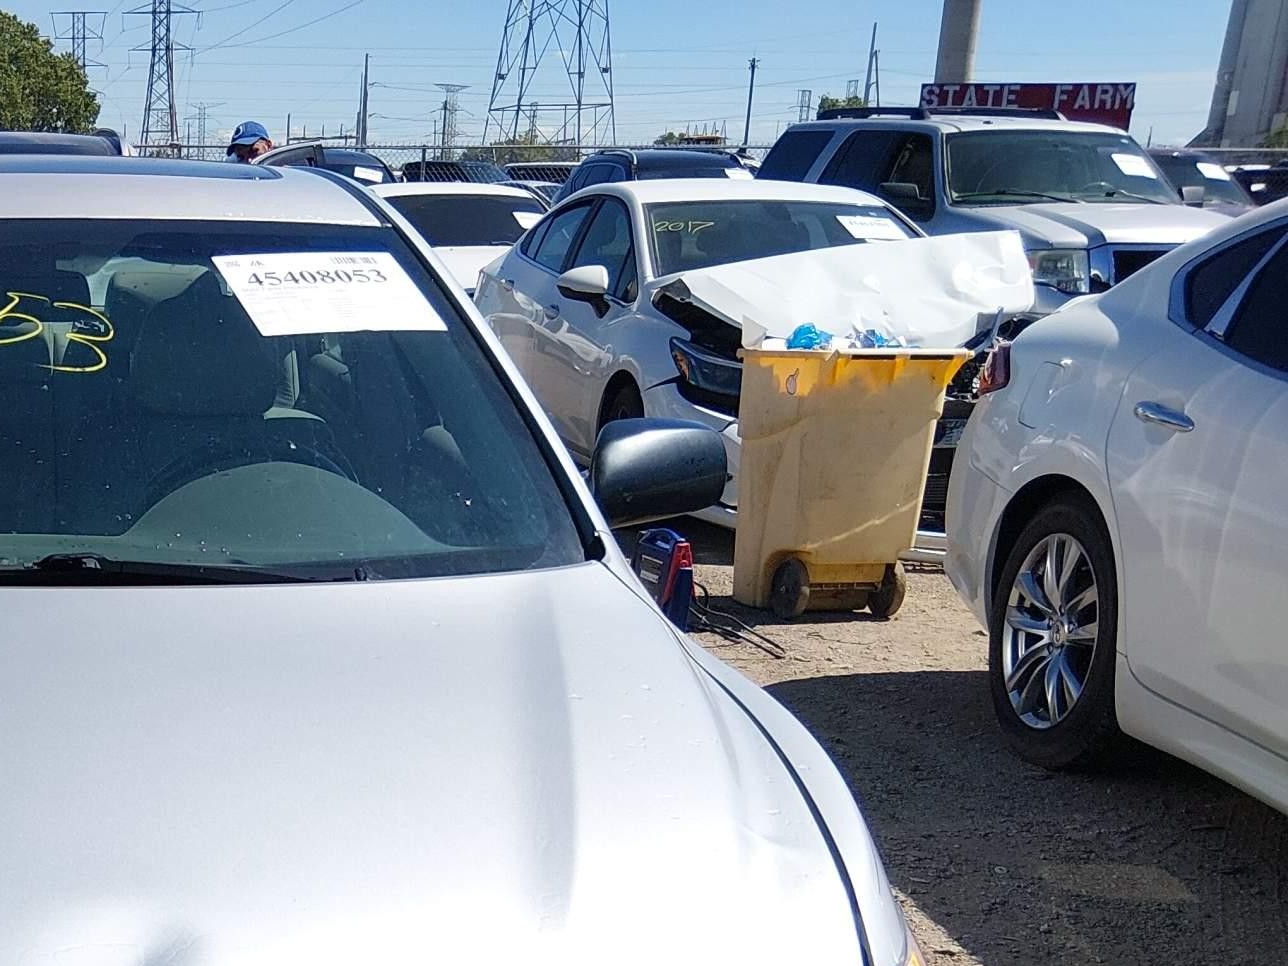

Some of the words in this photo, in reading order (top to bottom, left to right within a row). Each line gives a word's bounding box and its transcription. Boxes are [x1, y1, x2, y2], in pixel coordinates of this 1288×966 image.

[921, 84, 1021, 110] STATE
[1052, 84, 1135, 111] FARM
[655, 220, 715, 234] 2017
[247, 268, 388, 286] 45408053
